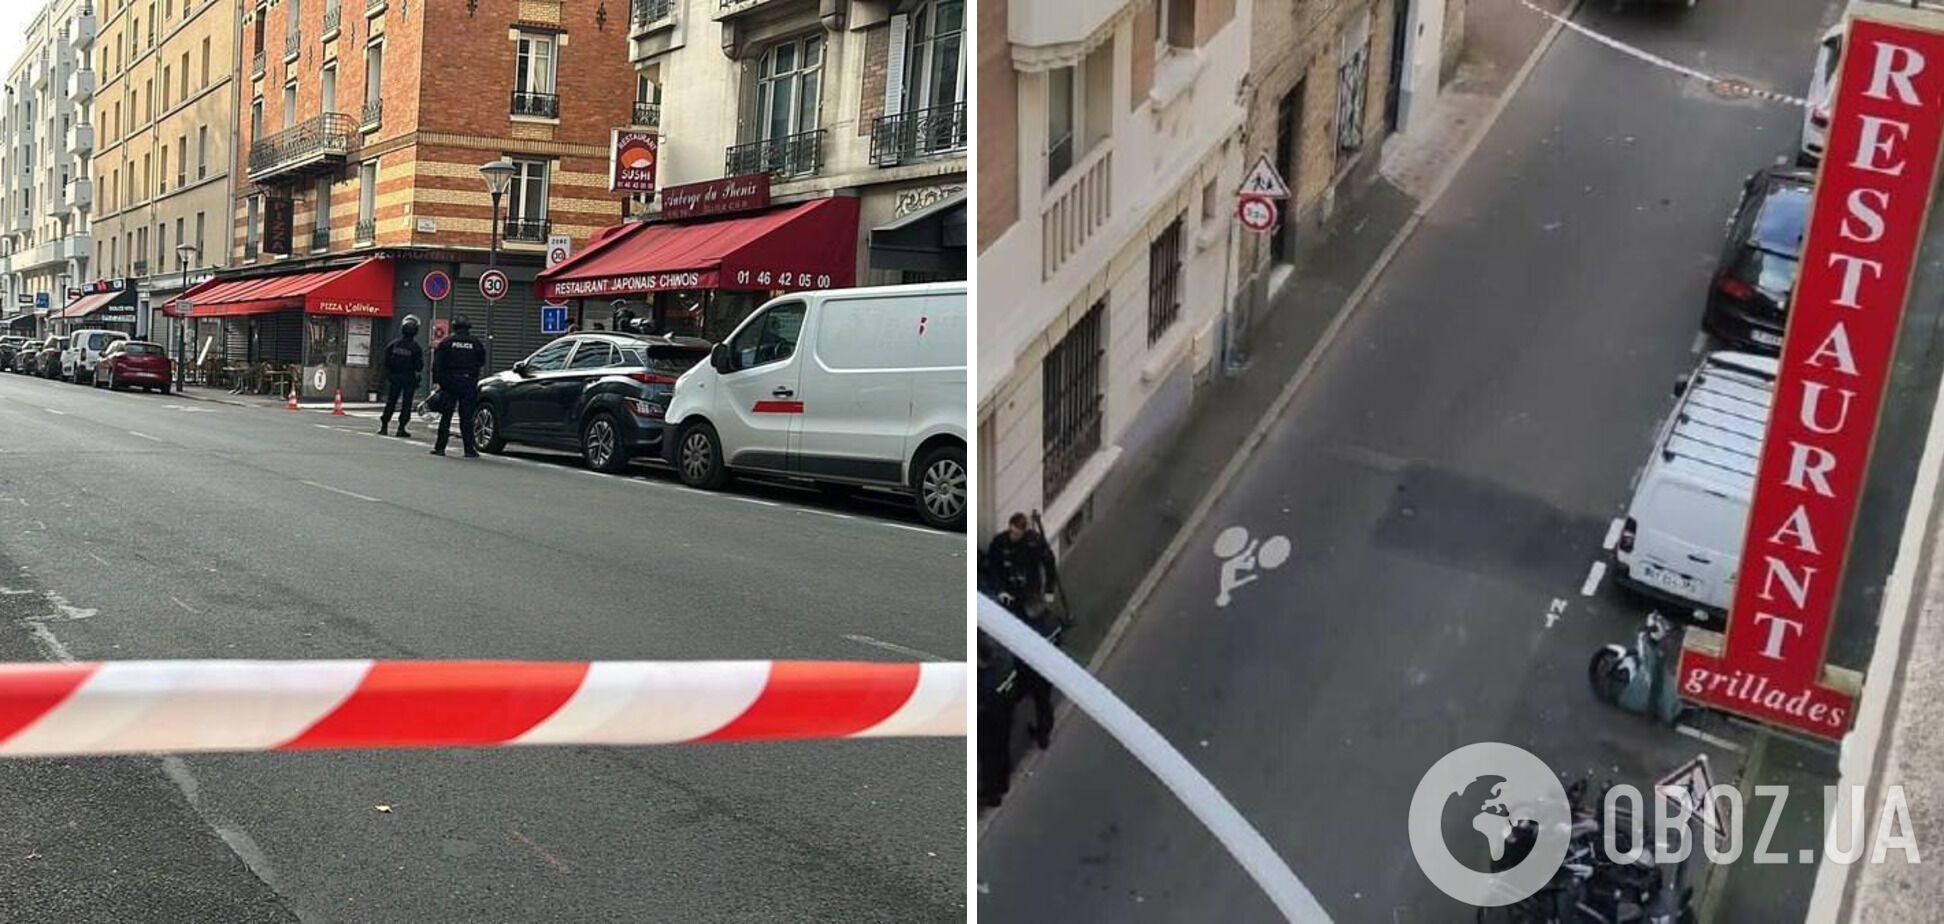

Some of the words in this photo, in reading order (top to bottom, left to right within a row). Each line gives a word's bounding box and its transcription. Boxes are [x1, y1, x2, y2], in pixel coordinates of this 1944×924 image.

[617, 132, 657, 151] RESTAURANT
[621, 169, 651, 181] SUSHI
[664, 189, 701, 211] Auberge
[704, 185, 717, 201] du
[486, 278, 502, 291] 30
[555, 278, 609, 295] RESTAURANT
[611, 275, 656, 292] JAPONAIS
[659, 272, 700, 287] CHINOIS
[737, 270, 750, 285] 01
[757, 270, 772, 285] 46
[778, 271, 792, 286] 42
[798, 273, 812, 287] 05
[816, 274, 831, 289] 00
[319, 302, 343, 311] PIZZA
[451, 341, 474, 350] POLICE
[1755, 41, 1926, 661] RESTAURANT
[1685, 668, 1846, 728] grillades
